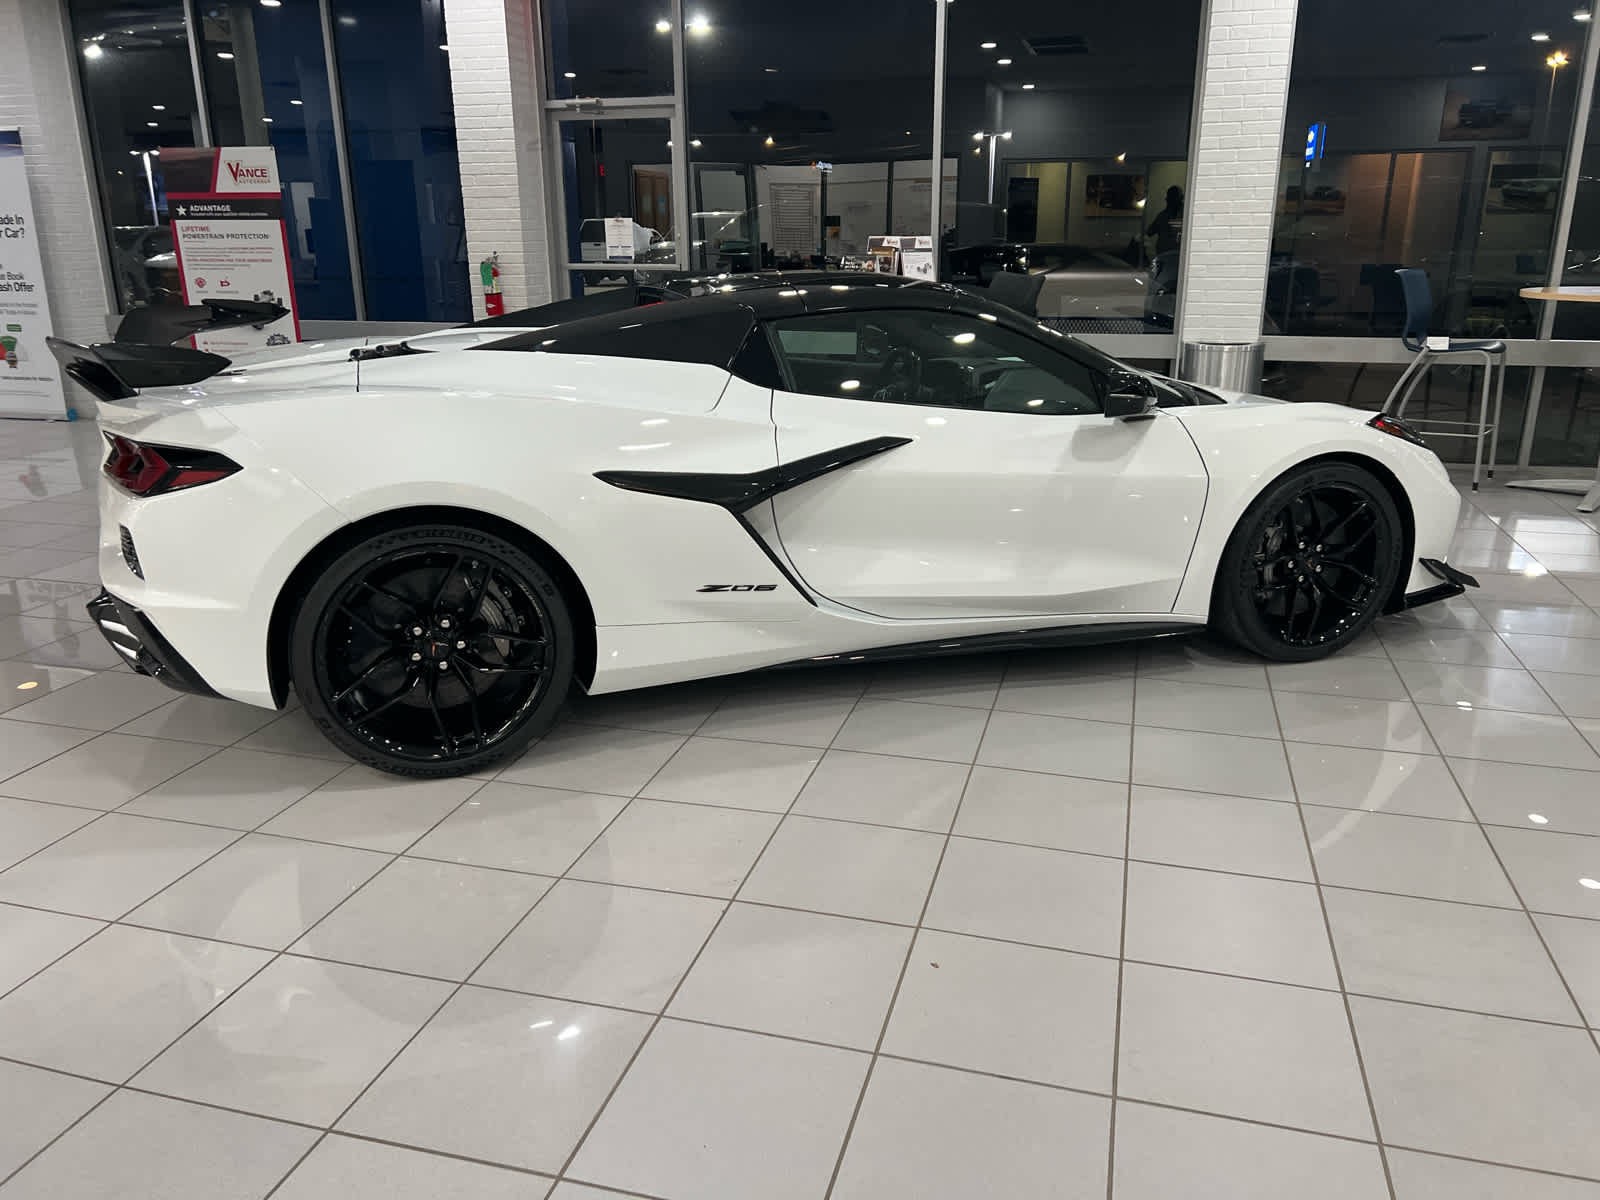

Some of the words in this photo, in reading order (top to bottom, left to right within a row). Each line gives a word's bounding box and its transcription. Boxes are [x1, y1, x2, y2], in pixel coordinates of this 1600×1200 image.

[226, 162, 268, 183] VANCE
[190, 204, 232, 212] ADVANTAGE
[4, 227, 25, 239] Car?
[6, 271, 25, 281] Book
[13, 281, 35, 292] Offer
[695, 584, 779, 593] Z06
